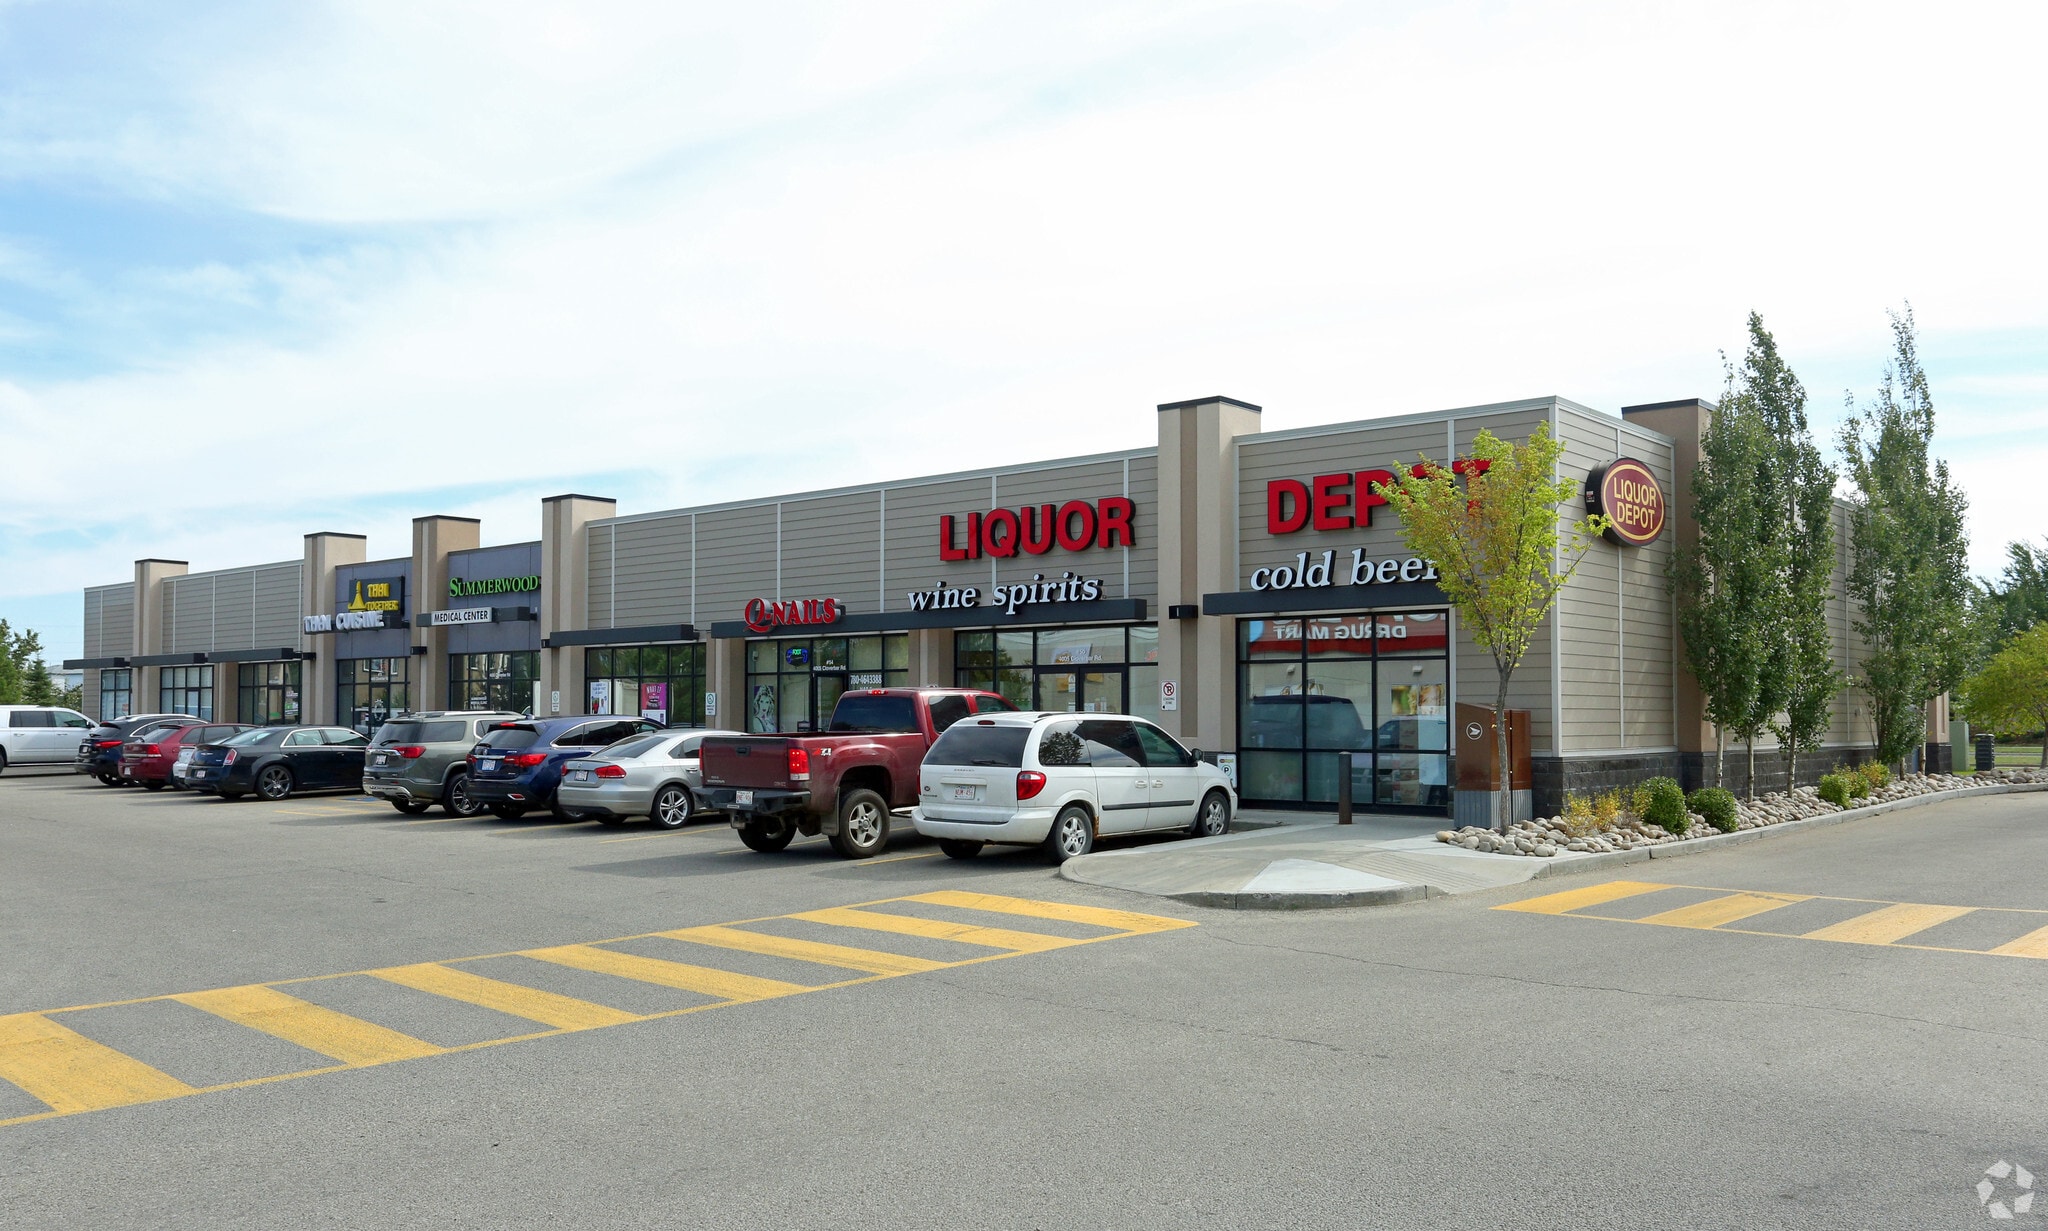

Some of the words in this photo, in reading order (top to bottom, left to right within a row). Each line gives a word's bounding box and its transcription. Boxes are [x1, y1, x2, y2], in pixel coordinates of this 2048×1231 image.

[1267, 458, 1494, 535] DEPT
[1613, 476, 1657, 508] LIQUOR
[940, 497, 1136, 561] LIQUOR
[1616, 501, 1656, 529] DEPOT
[1250, 549, 1336, 591] cold
[367, 583, 391, 598] THAI
[907, 581, 980, 611] wine
[991, 571, 1103, 615] spirits
[303, 614, 332, 633] THAI
[336, 610, 385, 631] CUISINE
[434, 611, 462, 622] MEDICAL
[463, 610, 488, 621] CENTER
